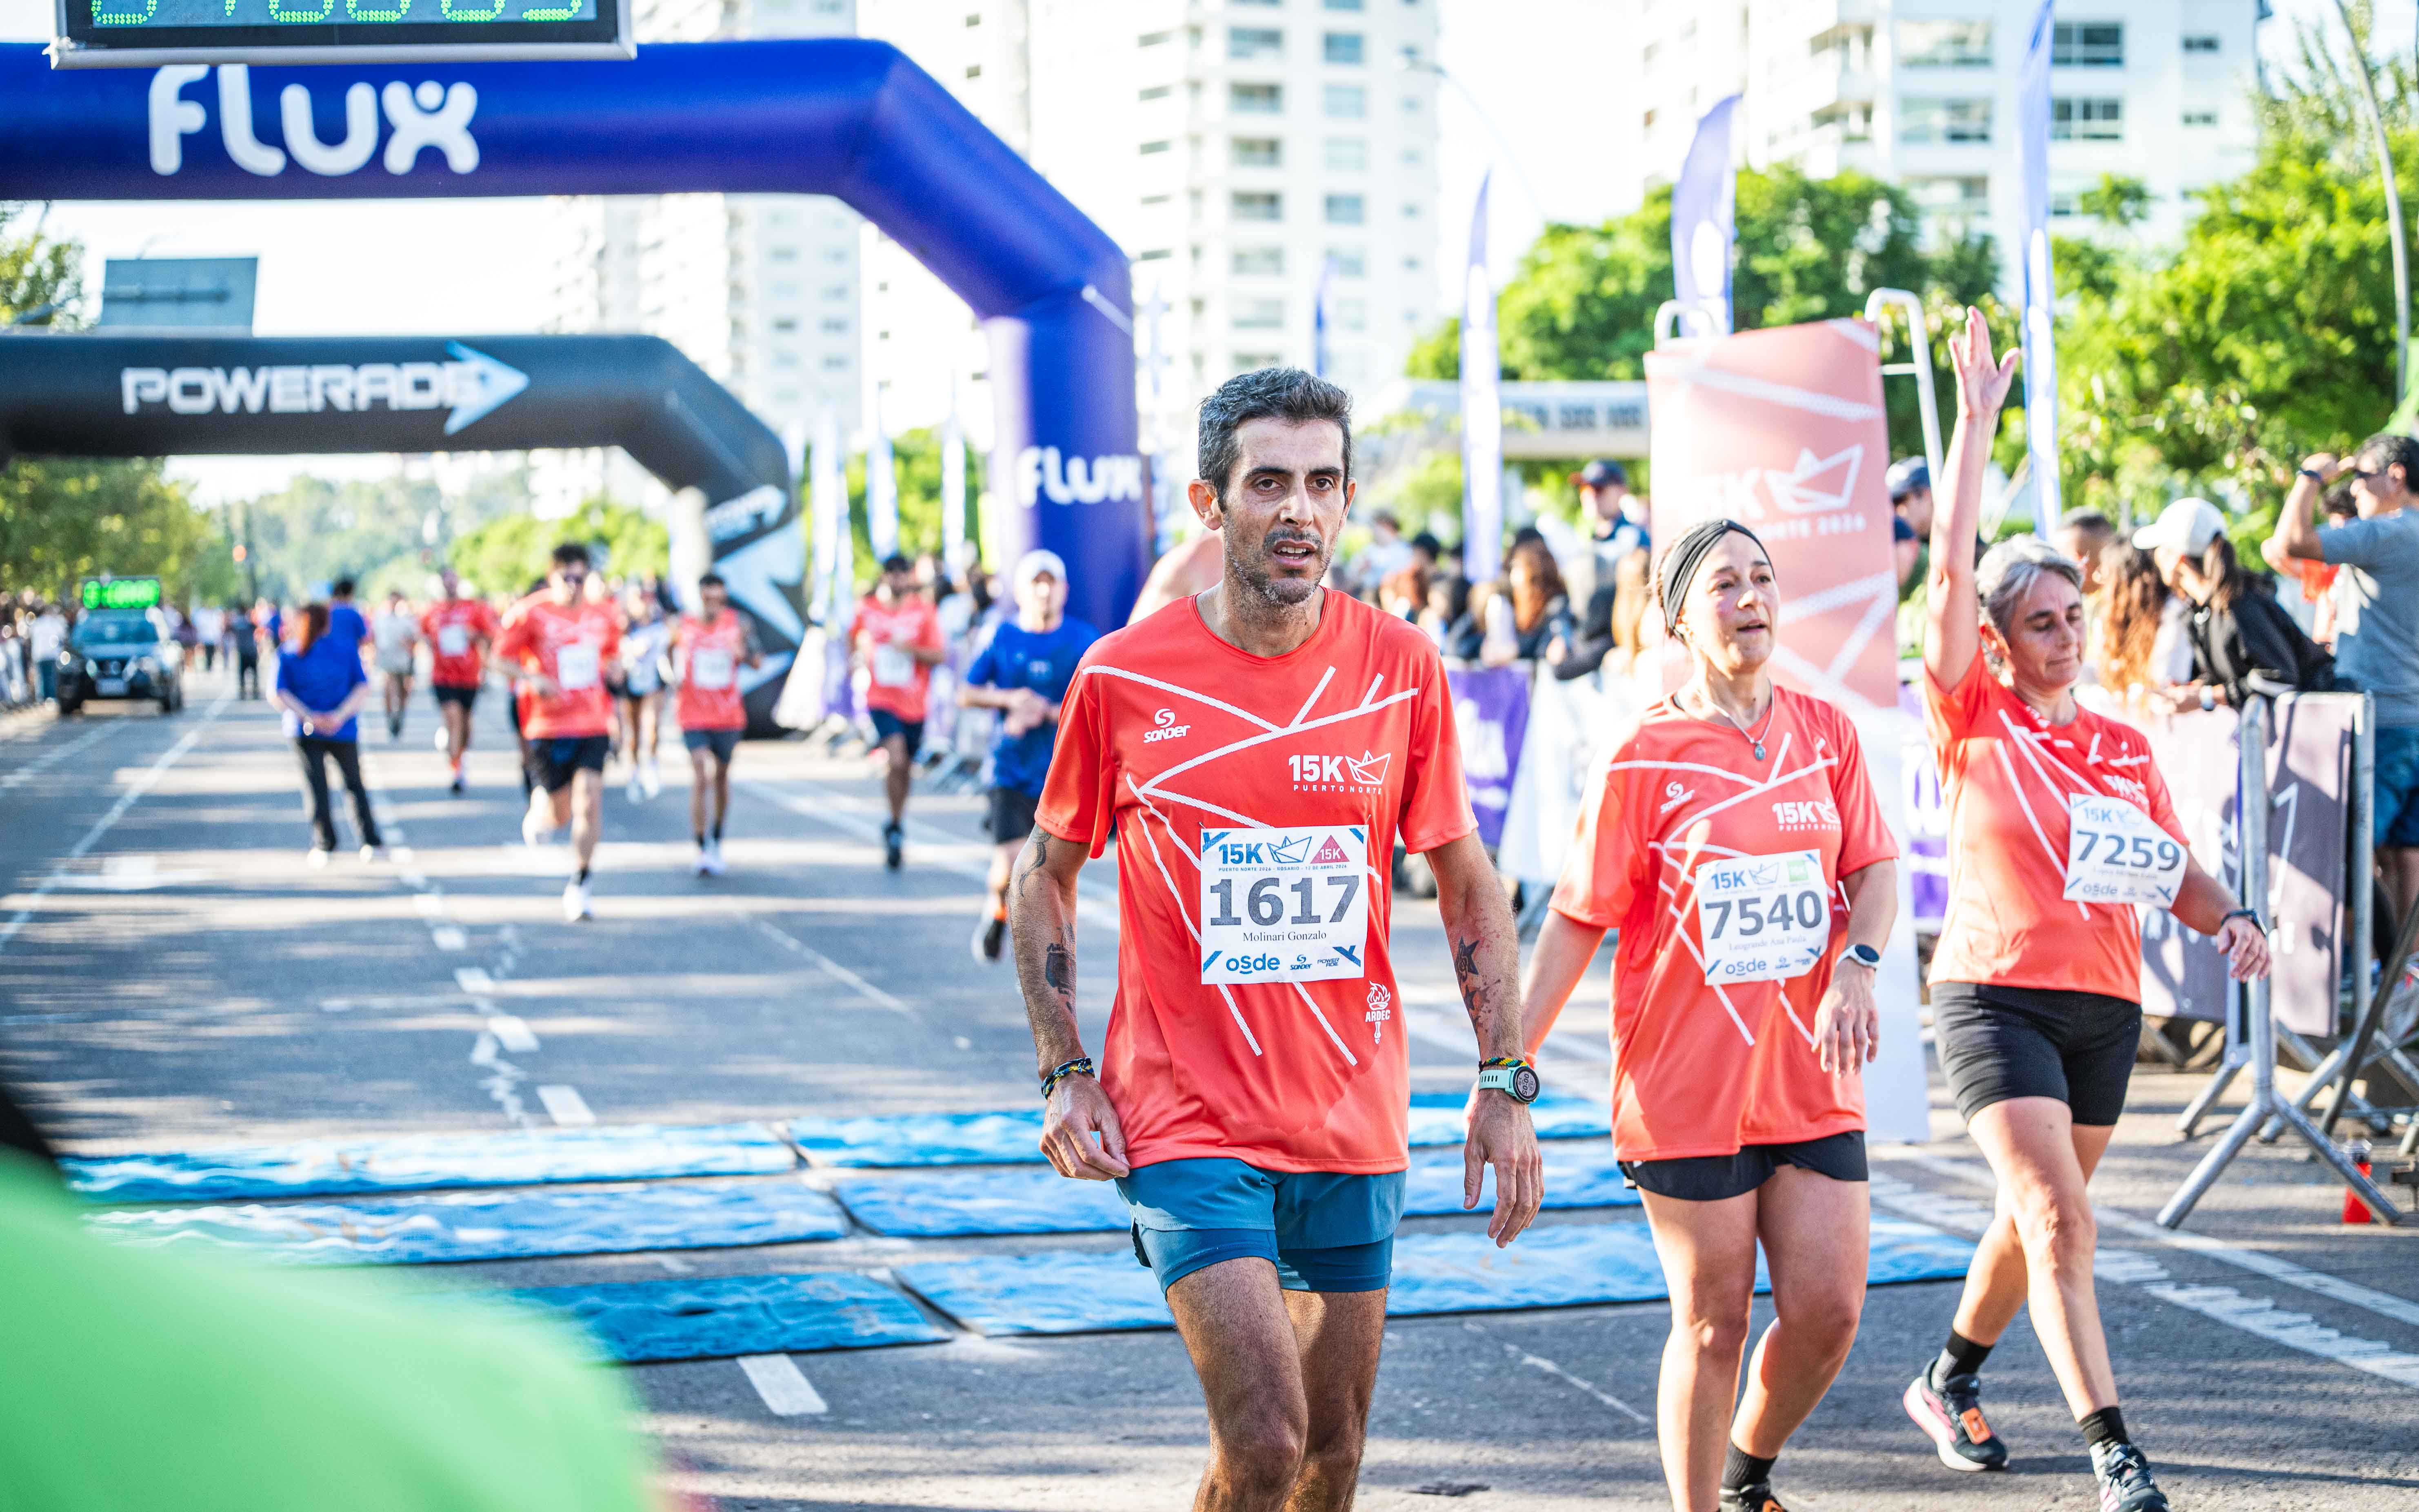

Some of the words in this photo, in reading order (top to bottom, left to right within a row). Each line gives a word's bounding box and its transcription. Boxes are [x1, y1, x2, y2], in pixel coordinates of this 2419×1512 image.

[120, 361, 486, 415] POWERADE
[1288, 754, 1345, 782] 15K
[1293, 784, 1345, 793] PUERTO
[1772, 801, 1818, 824] 15K
[2083, 808, 2112, 823] 15K
[1218, 843, 1264, 864] 15K
[1319, 848, 1341, 859] 15K
[2076, 830, 2180, 871] 7259
[1711, 870, 1746, 889] 15K
[1210, 875, 1359, 926] 1617
[1705, 890, 1822, 939] 7540
[1243, 932, 1284, 942] Molinari
[1288, 930, 1326, 941] Gonzalo
[1226, 953, 1280, 972] osde
[1726, 958, 1766, 975] osde
[1365, 1009, 1391, 1022] ARDEC
